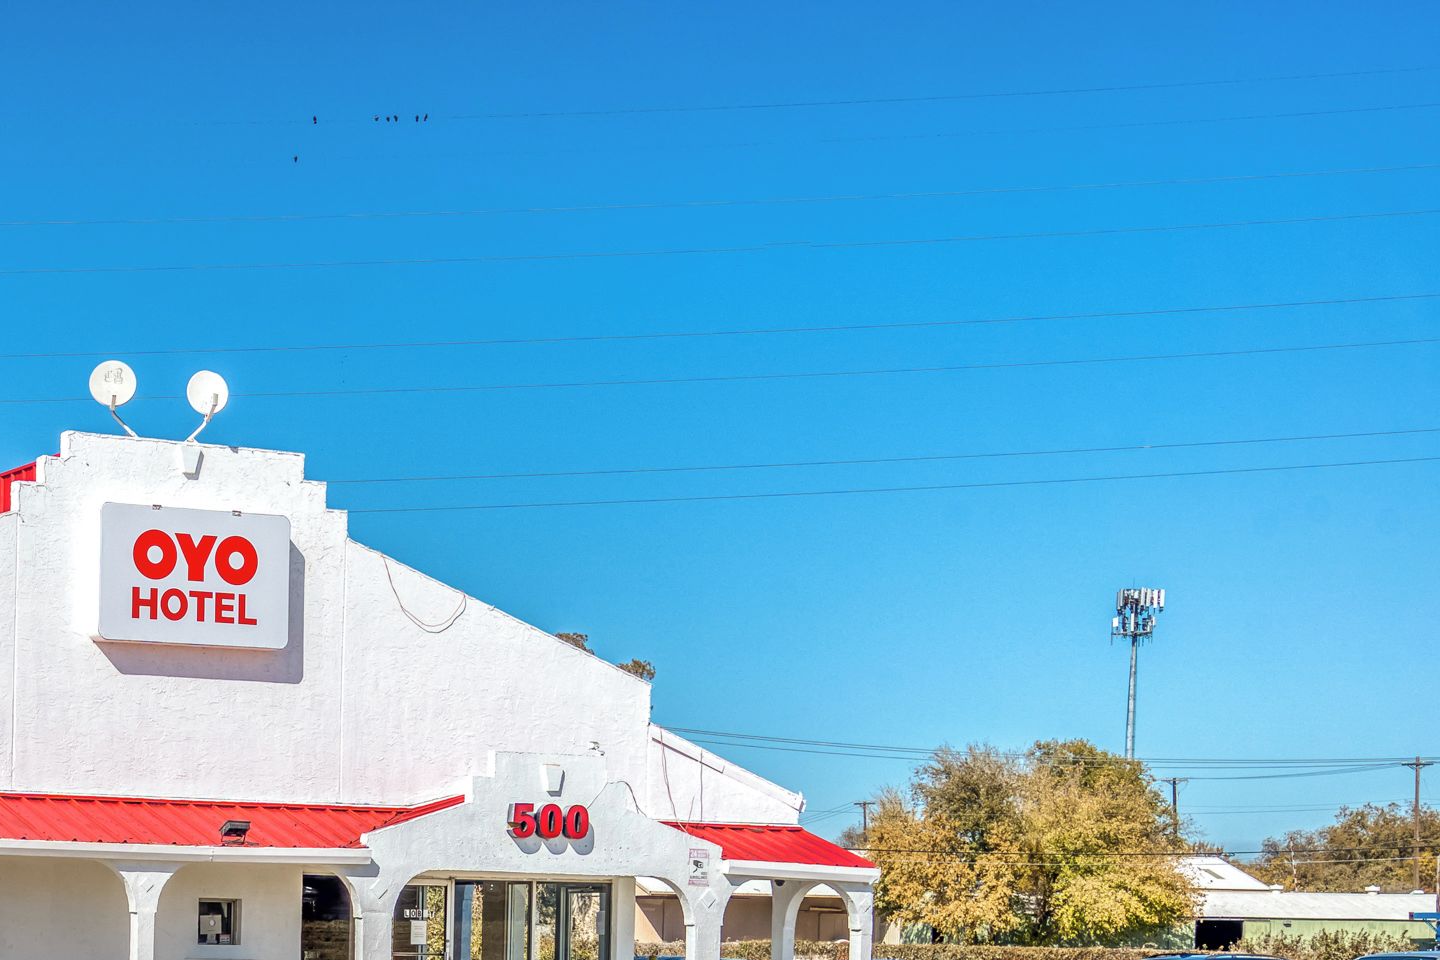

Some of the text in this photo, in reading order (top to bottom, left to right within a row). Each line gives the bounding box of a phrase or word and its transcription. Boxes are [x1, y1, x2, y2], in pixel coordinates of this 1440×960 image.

[133, 529, 259, 585] OYO
[131, 586, 258, 625] HOTEL
[512, 802, 590, 840] 500
[404, 909, 435, 918] LOBY
